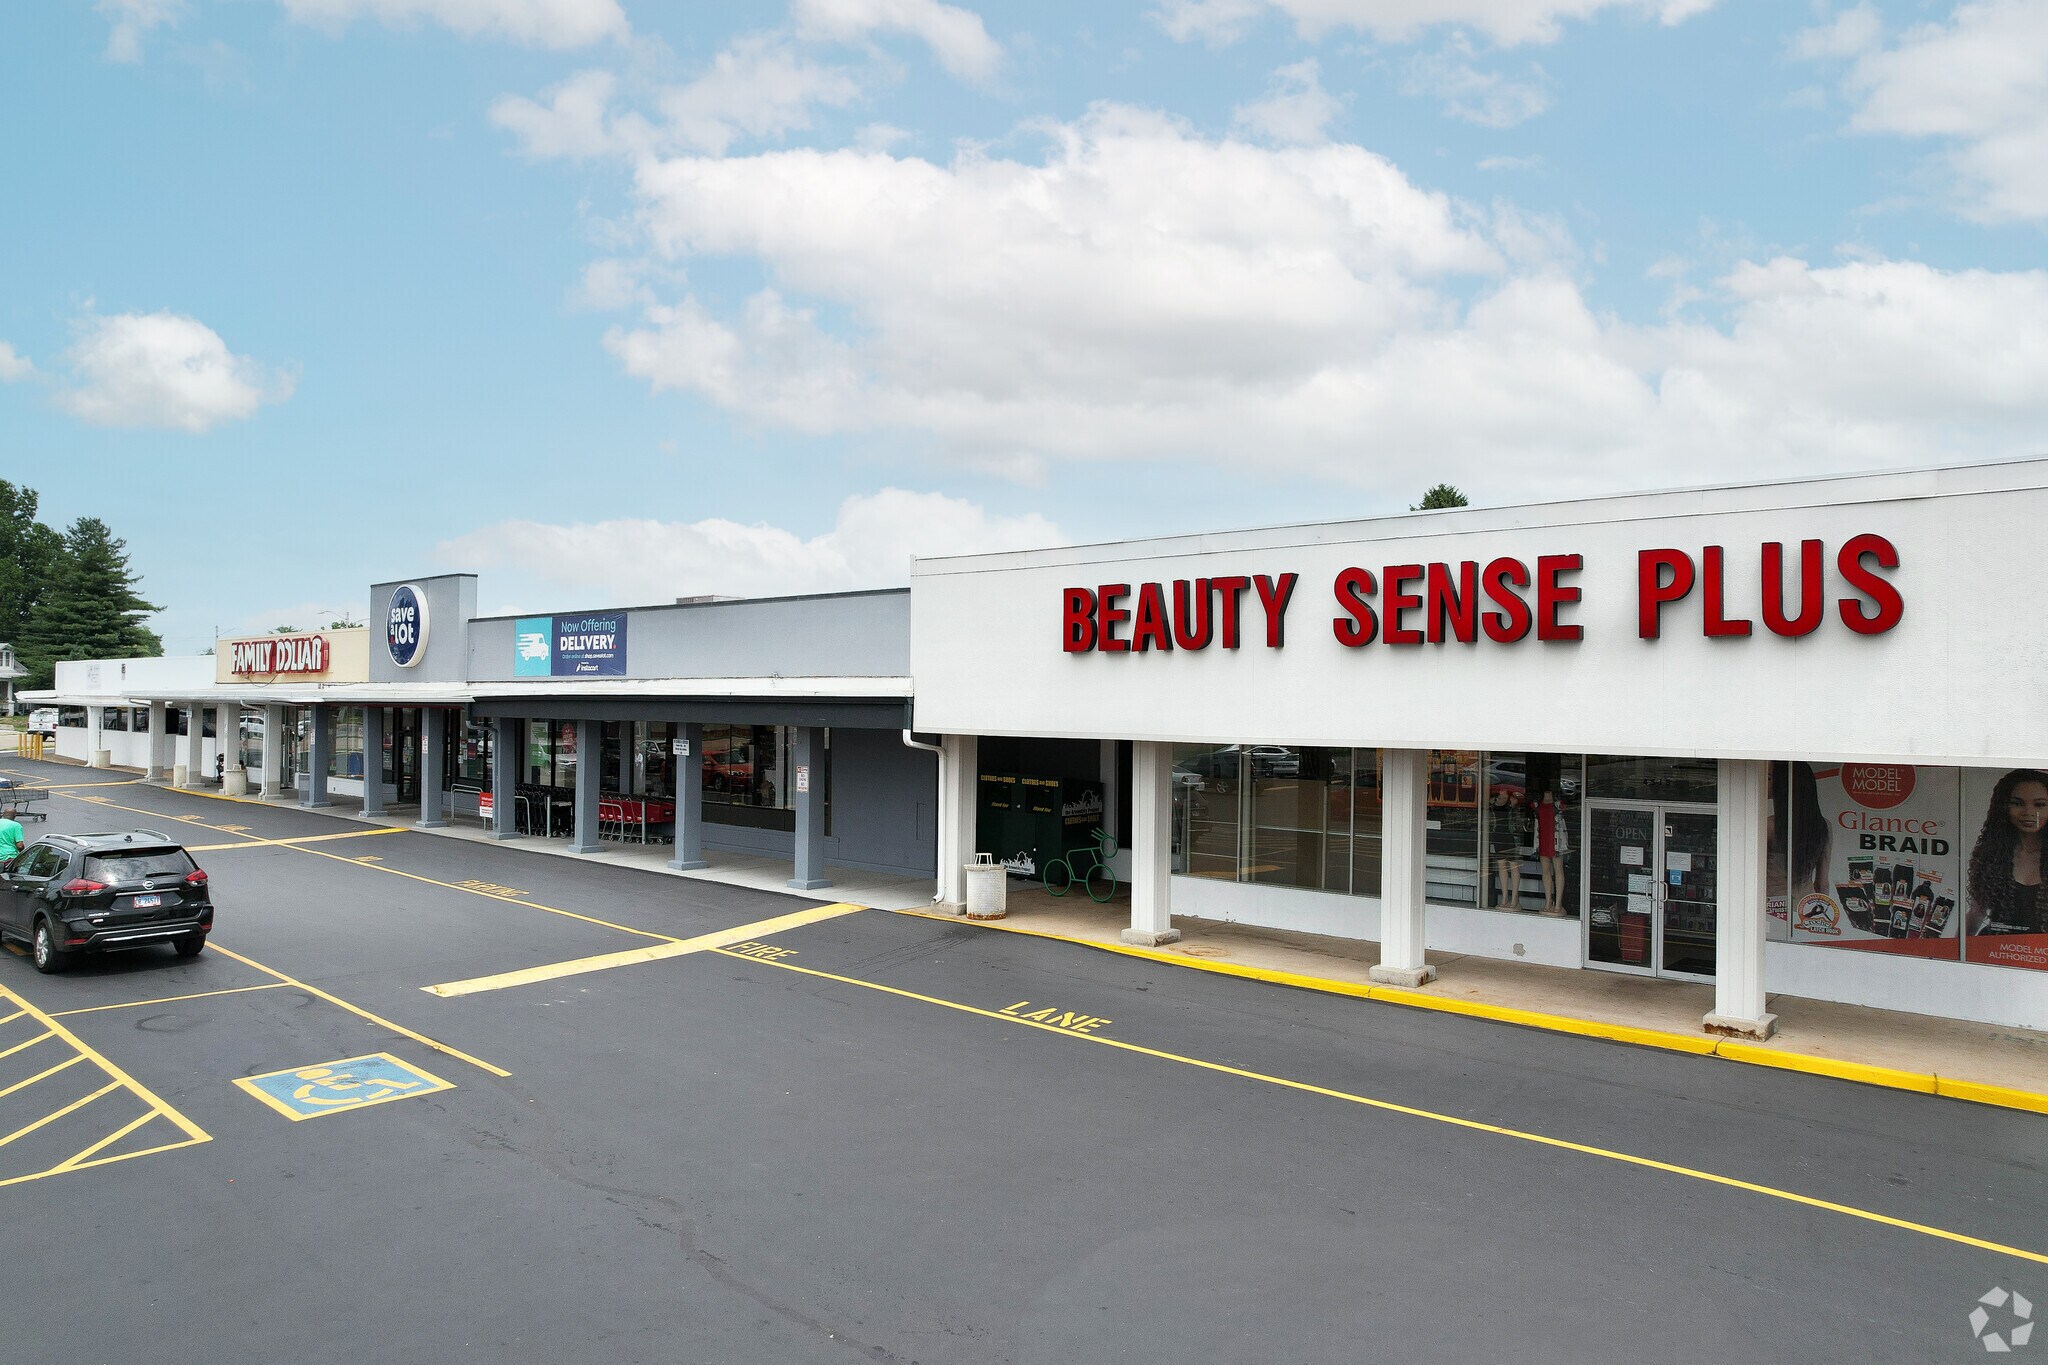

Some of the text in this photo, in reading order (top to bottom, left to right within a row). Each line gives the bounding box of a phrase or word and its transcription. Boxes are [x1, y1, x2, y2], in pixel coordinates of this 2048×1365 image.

[1063, 533, 1905, 653] BEAUTY SENSE PLUS
[391, 606, 415, 623] save
[561, 617, 616, 633] Now Offering
[560, 634, 617, 651] DELIVERY.
[231, 636, 323, 673] FAMILY DOLLAR
[1852, 767, 1902, 780] MODEL
[1852, 778, 1902, 792] MODEL
[1838, 811, 1938, 836] Glance
[1615, 826, 1647, 840] OPEN
[1859, 833, 1950, 856] BRAID
[726, 941, 800, 961] FIRE
[1999, 943, 2032, 954] MODEL
[1988, 951, 2047, 964] AUTHORIZED
[999, 1001, 1113, 1033] LANE
